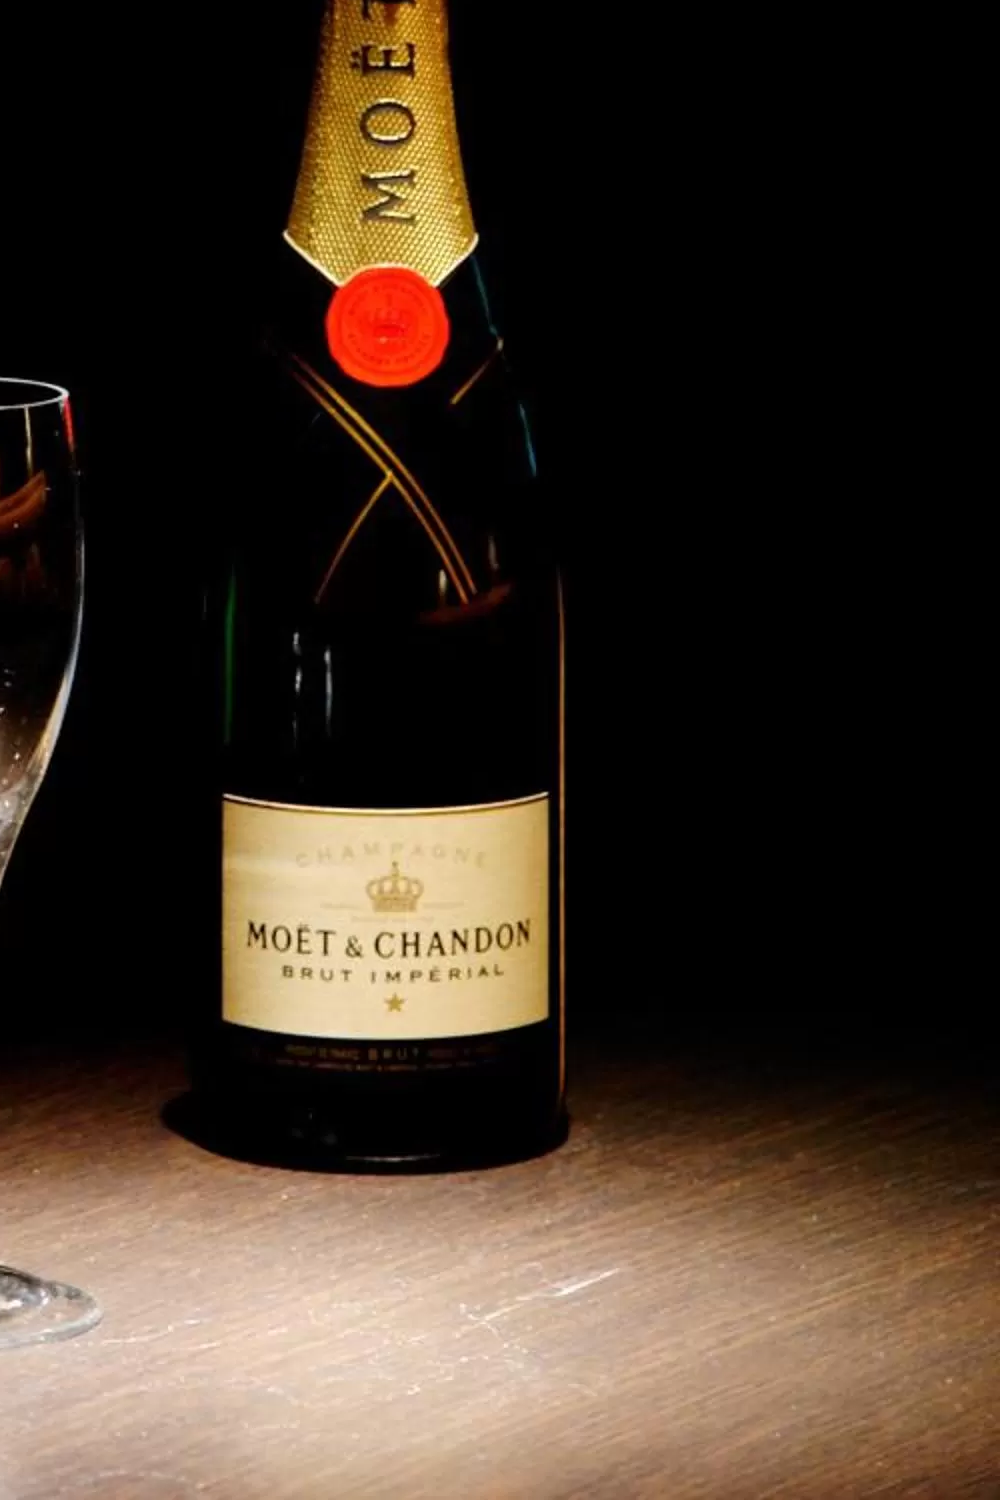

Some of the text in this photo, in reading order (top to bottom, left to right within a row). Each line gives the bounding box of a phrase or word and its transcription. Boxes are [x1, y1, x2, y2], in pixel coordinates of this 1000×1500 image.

[295, 841, 488, 868] CHAMPAGNE
[247, 918, 532, 959] MOËT & CHANDON
[281, 963, 505, 985] BRUT IMPÉRIAL
